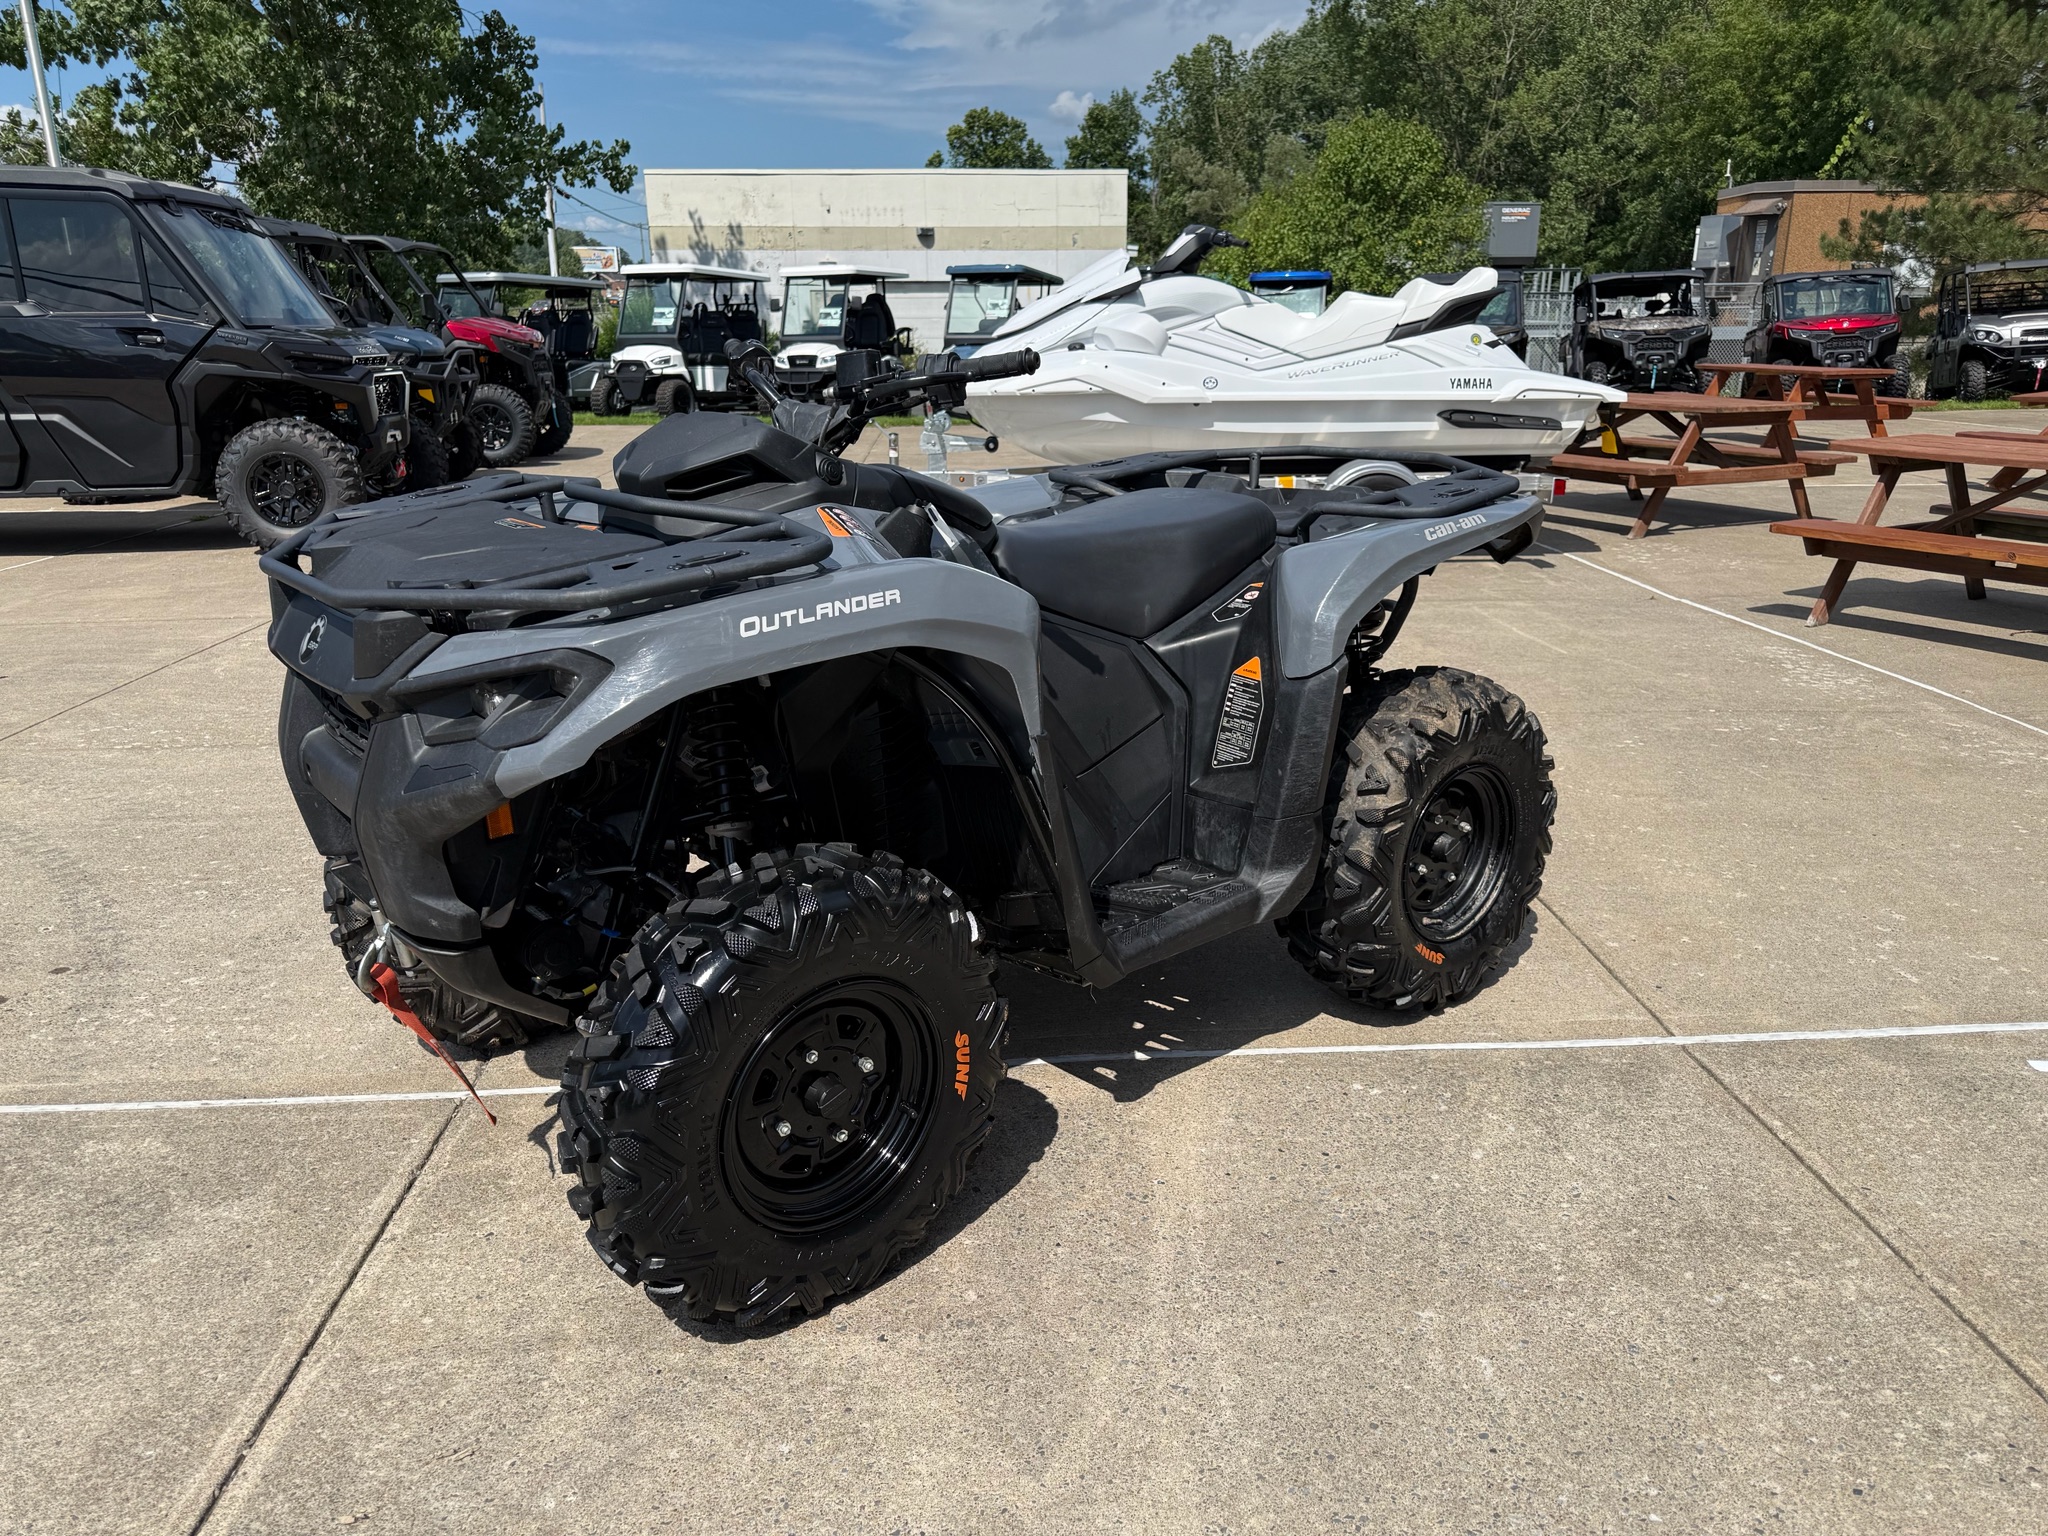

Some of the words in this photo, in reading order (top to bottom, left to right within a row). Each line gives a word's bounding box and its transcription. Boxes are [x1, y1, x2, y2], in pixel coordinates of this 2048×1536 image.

[1637, 342, 1675, 350] CFMOTO
[1287, 350, 1400, 380] WAVERUNNER
[1449, 377, 1493, 390] YAMAHA
[1423, 513, 1487, 542] can-am
[739, 588, 902, 639] OUTLANDER
[1414, 942, 1446, 965] SUNF
[954, 1029, 971, 1102] SUNF
